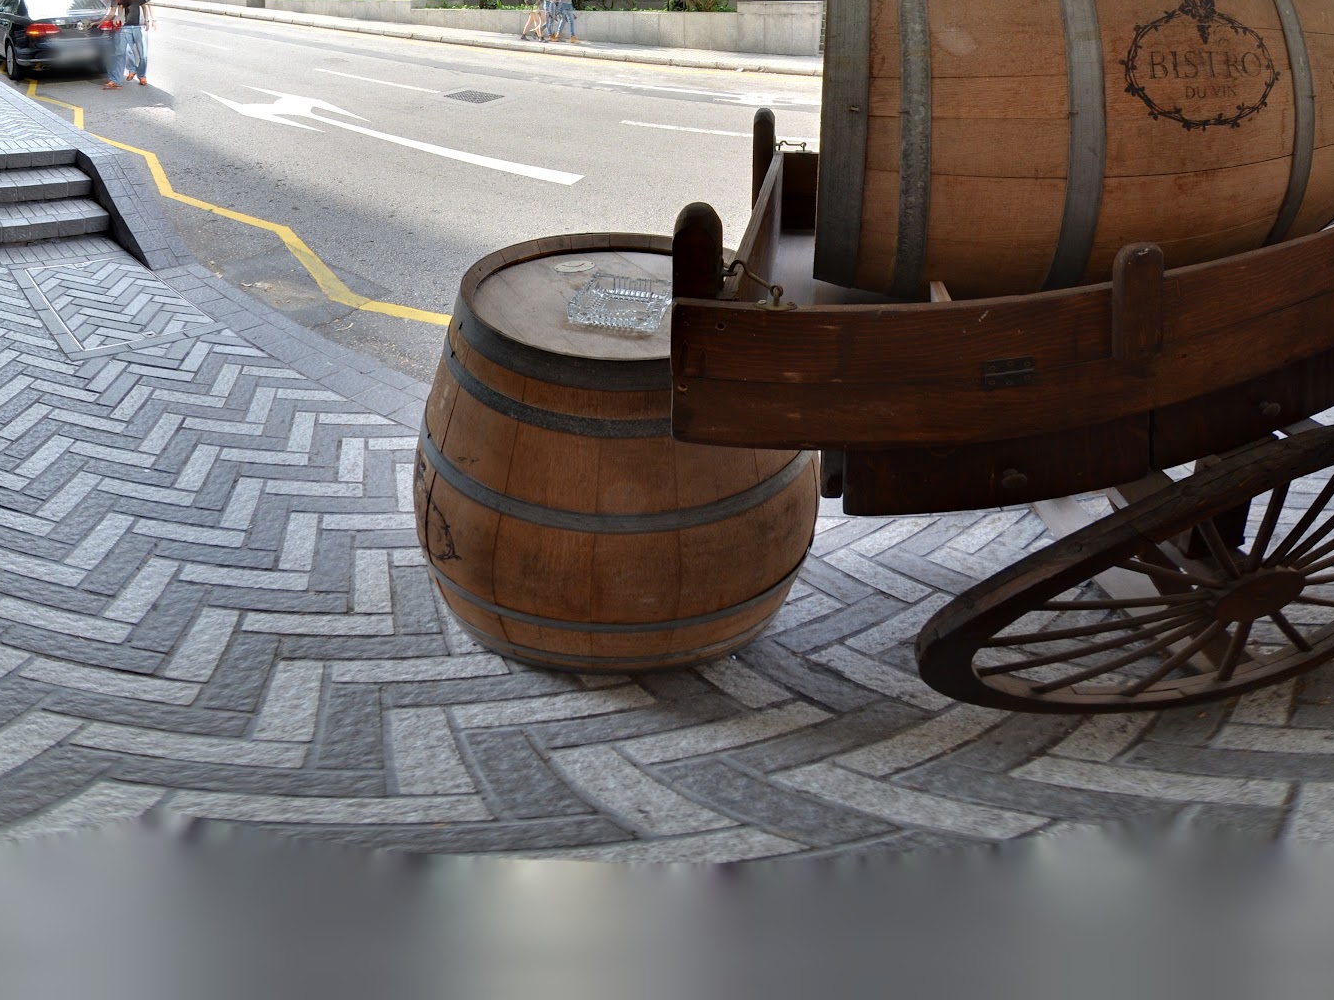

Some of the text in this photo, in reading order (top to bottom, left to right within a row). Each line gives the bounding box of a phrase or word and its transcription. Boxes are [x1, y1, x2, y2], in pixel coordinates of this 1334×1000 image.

[1148, 49, 1263, 80] BISTRO
[1185, 85, 1237, 99] DU VIN
